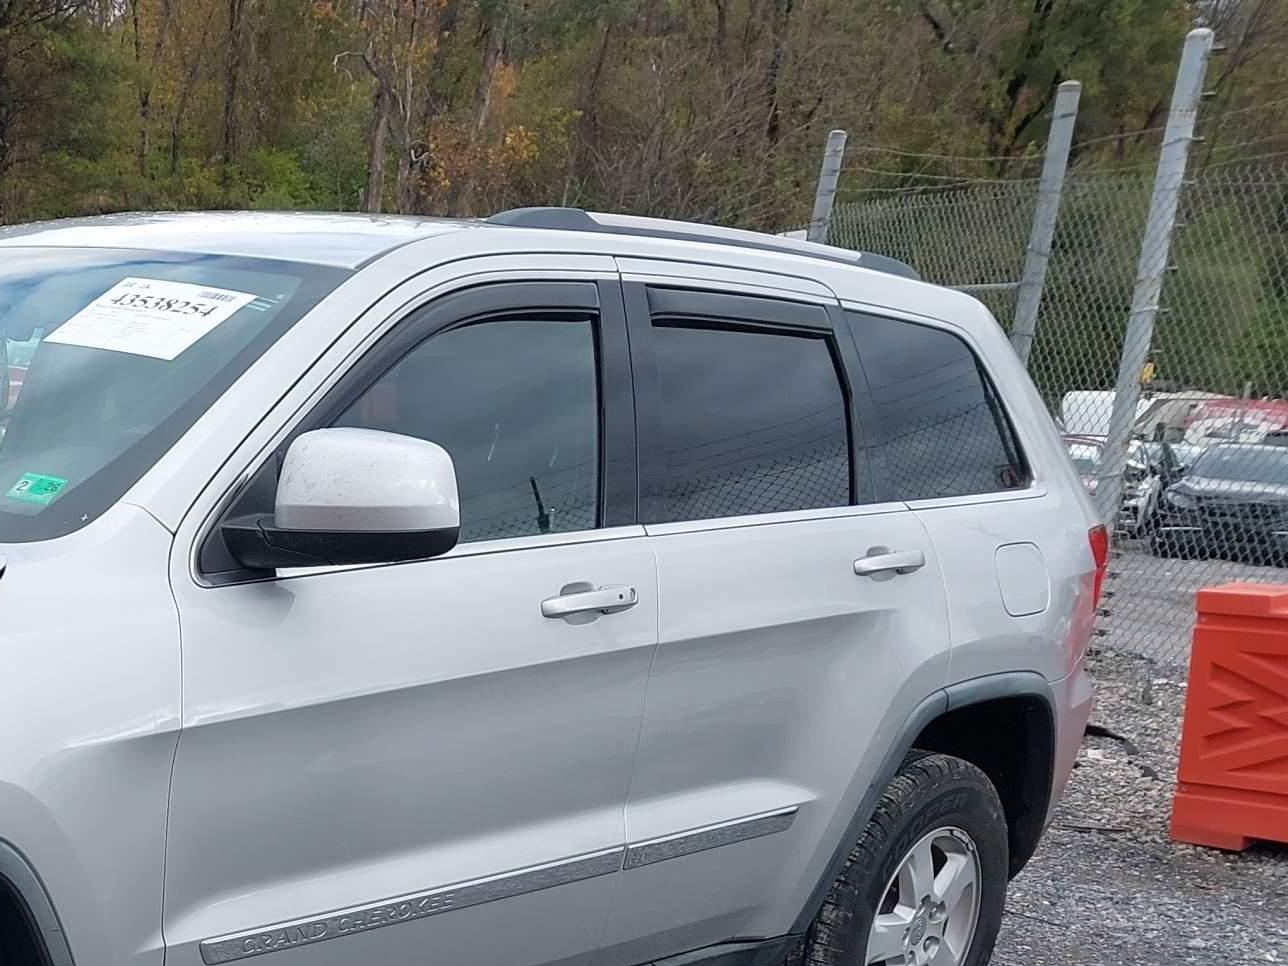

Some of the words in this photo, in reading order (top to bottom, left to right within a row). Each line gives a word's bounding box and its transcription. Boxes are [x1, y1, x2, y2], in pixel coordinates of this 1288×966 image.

[111, 292, 218, 317] 43538254
[16, 480, 30, 492] 2
[242, 922, 328, 955] GRAND
[338, 892, 456, 934] CHEROKEE
